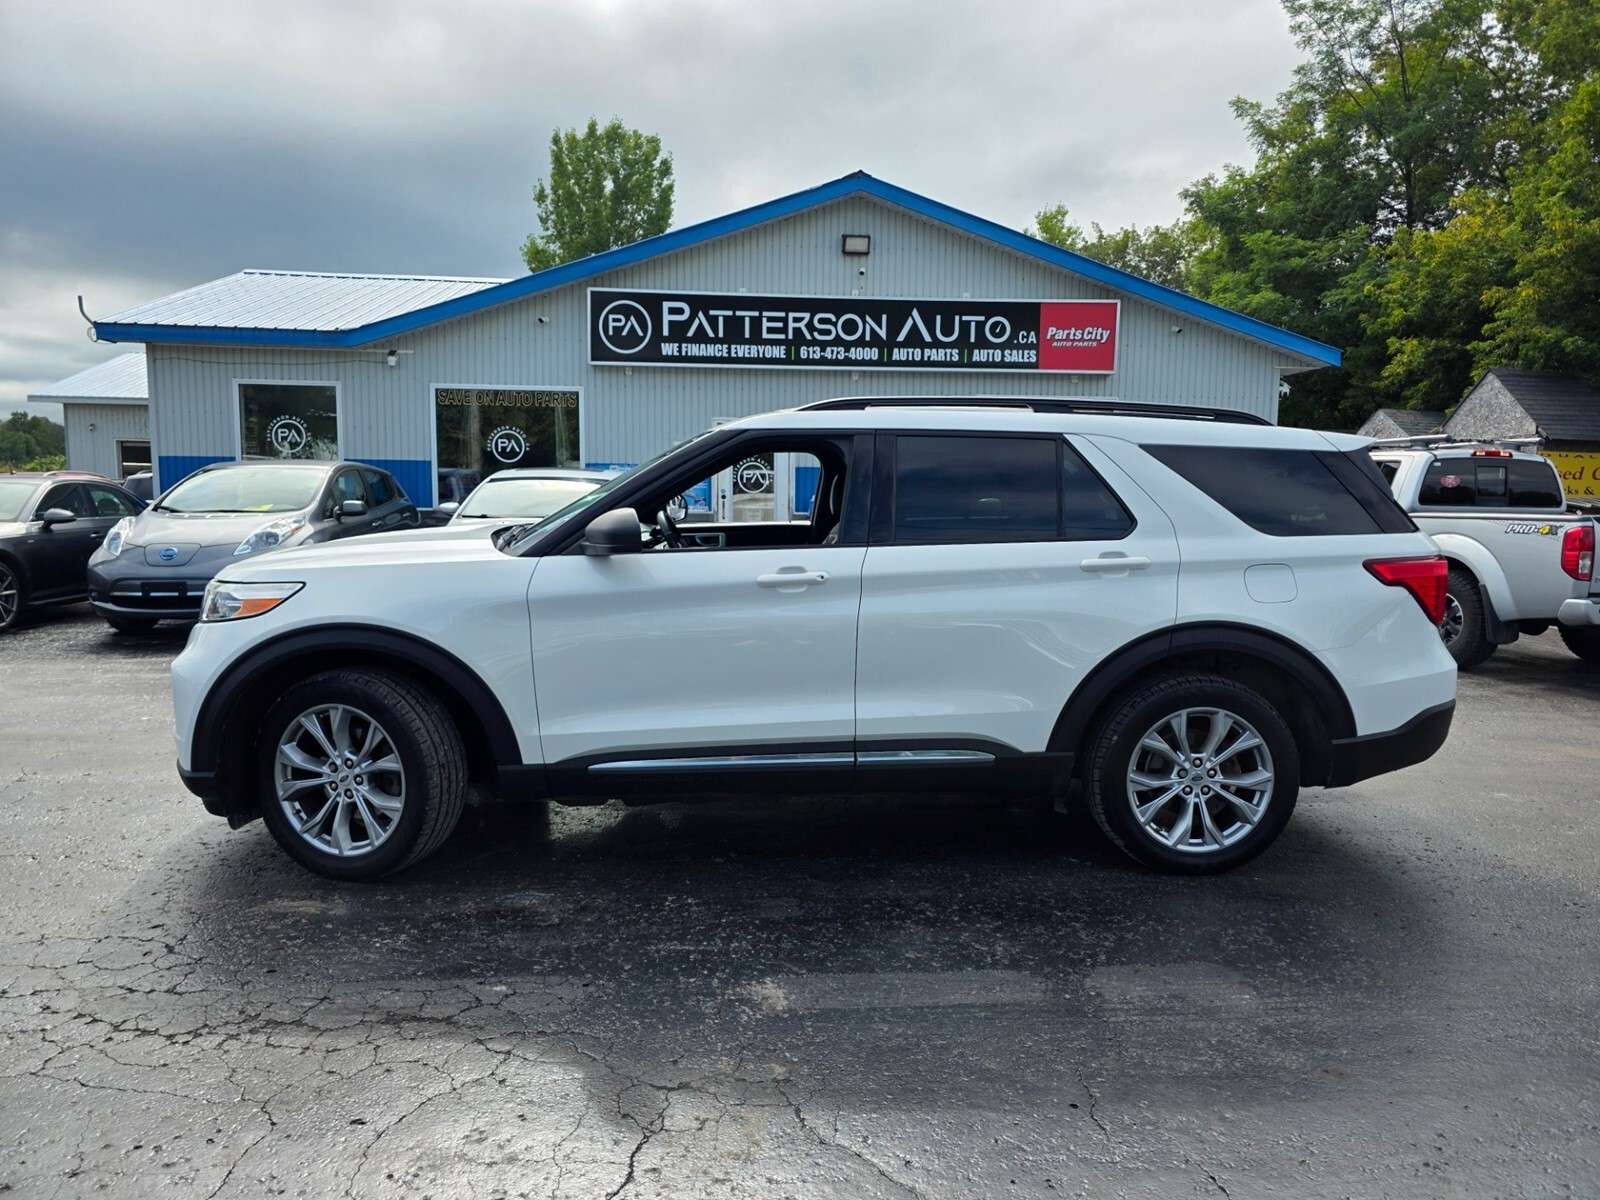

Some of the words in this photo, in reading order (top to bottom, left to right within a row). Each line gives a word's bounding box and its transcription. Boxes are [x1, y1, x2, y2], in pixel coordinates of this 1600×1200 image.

[608, 313, 644, 336] PA
[662, 301, 887, 342] PATTERSON
[896, 307, 1012, 344] AUTO
[661, 343, 680, 356] WE
[682, 343, 730, 358] FINANCE
[731, 344, 786, 359] EVERYONE
[800, 346, 879, 361] 613-473-4000
[892, 348, 922, 361] AUTO
[924, 348, 959, 362] PARTS
[972, 349, 1002, 363] AUTO
[1004, 349, 1037, 363] SALES
[437, 389, 473, 405] SAVE
[475, 390, 495, 406] ON
[496, 391, 533, 407] AUTO
[535, 391, 577, 408] PARTS
[277, 428, 301, 442] PA
[498, 438, 520, 453] PA
